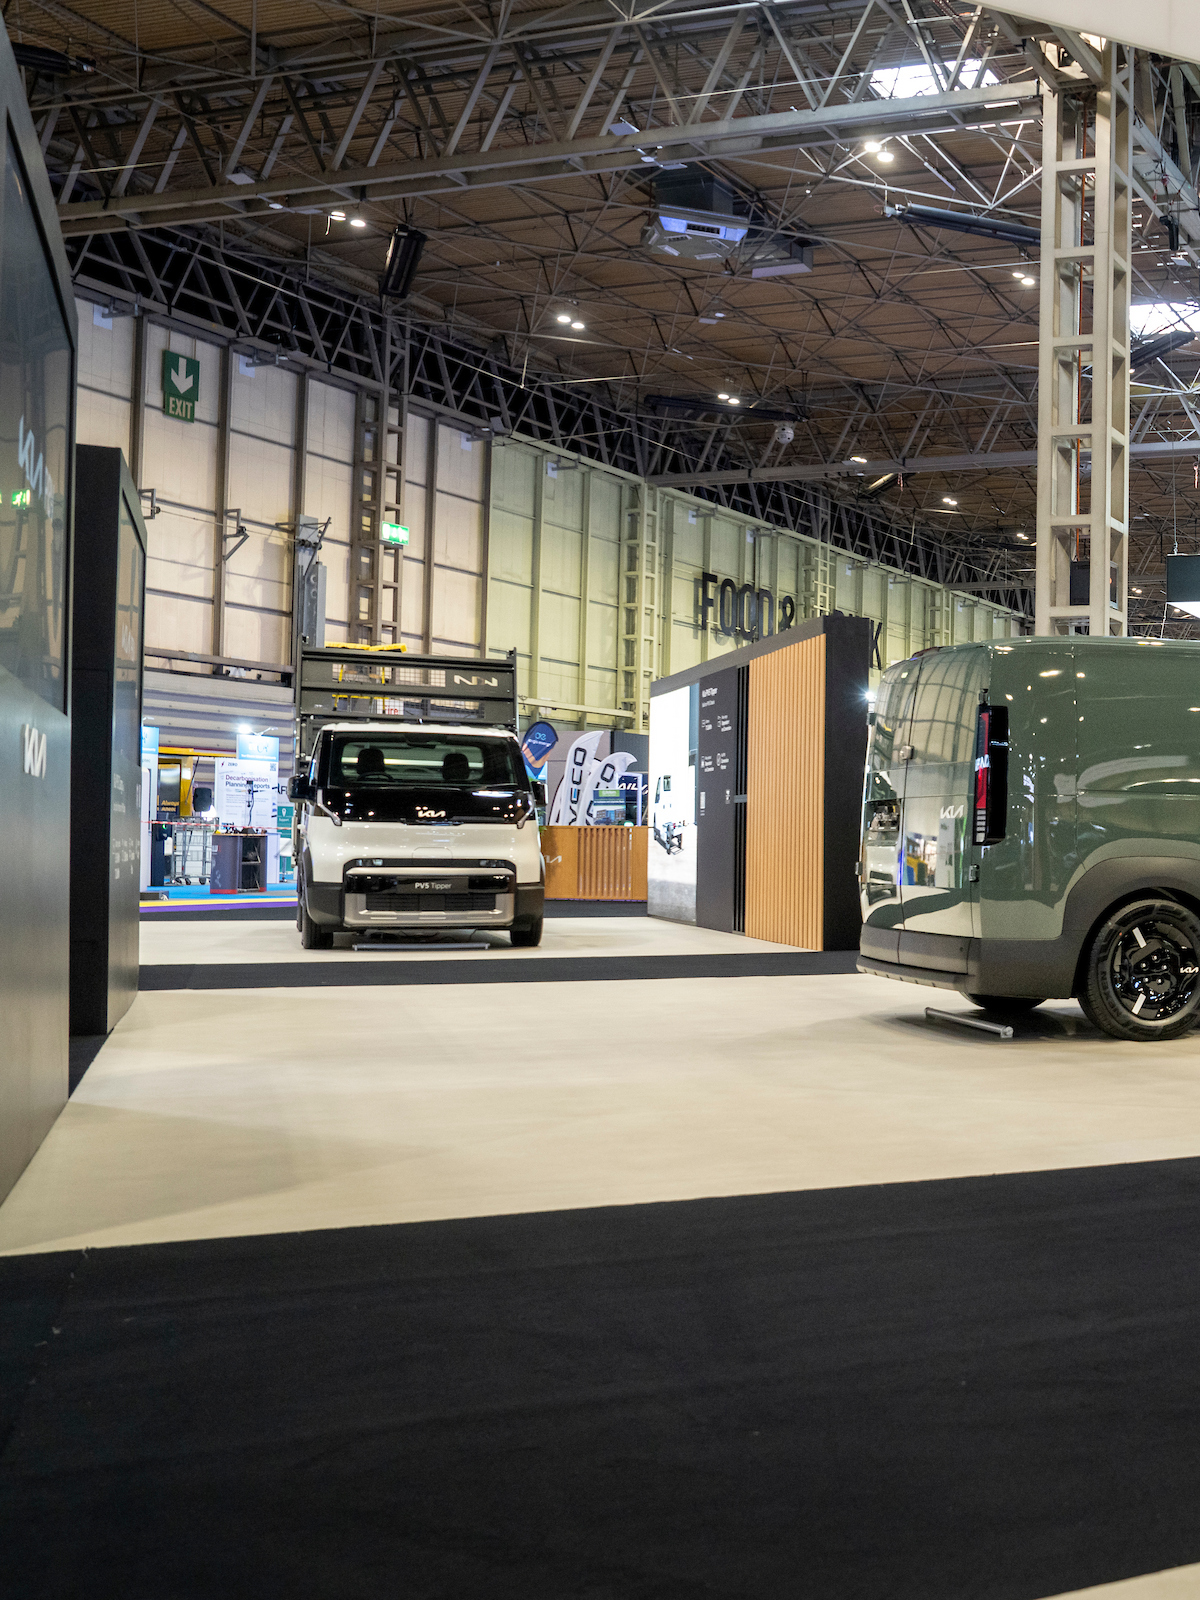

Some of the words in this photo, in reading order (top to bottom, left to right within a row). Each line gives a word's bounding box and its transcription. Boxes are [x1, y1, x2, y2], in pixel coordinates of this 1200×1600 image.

[169, 396, 193, 419] EXIT
[702, 572, 774, 640] FOOD
[225, 774, 268, 782] Decarbonisation
[569, 747, 587, 825] VECO
[431, 882, 452, 890] Tipper
